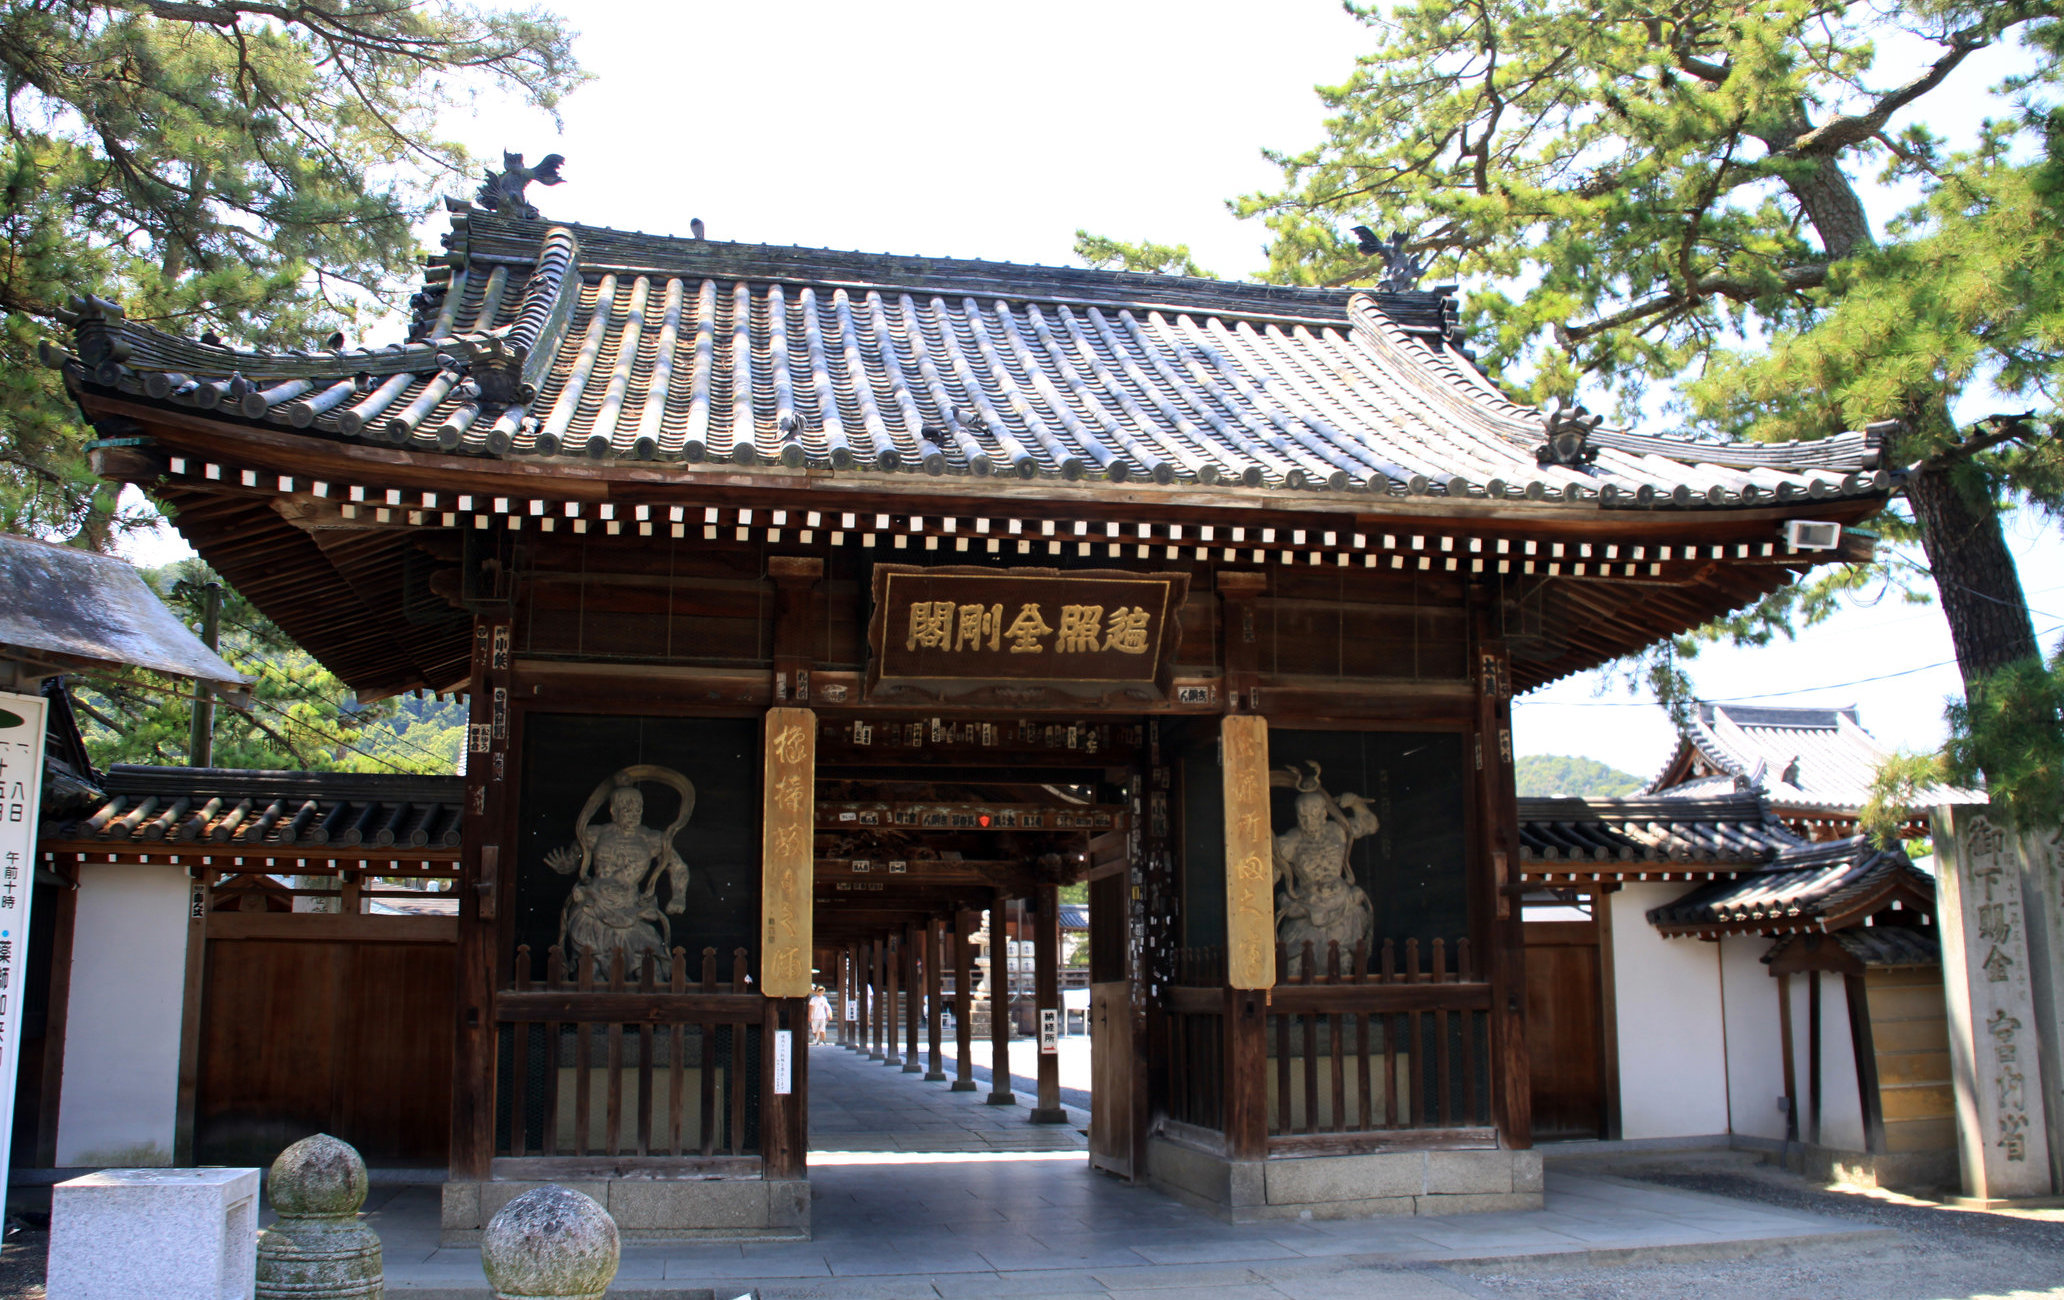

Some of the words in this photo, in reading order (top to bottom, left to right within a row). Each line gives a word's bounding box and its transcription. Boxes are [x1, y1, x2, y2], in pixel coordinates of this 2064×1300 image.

[2, 850, 20, 909] 午前十時
[1967, 816, 2014, 983] 御下賜金
[1045, 1011, 1055, 1044] 納経所
